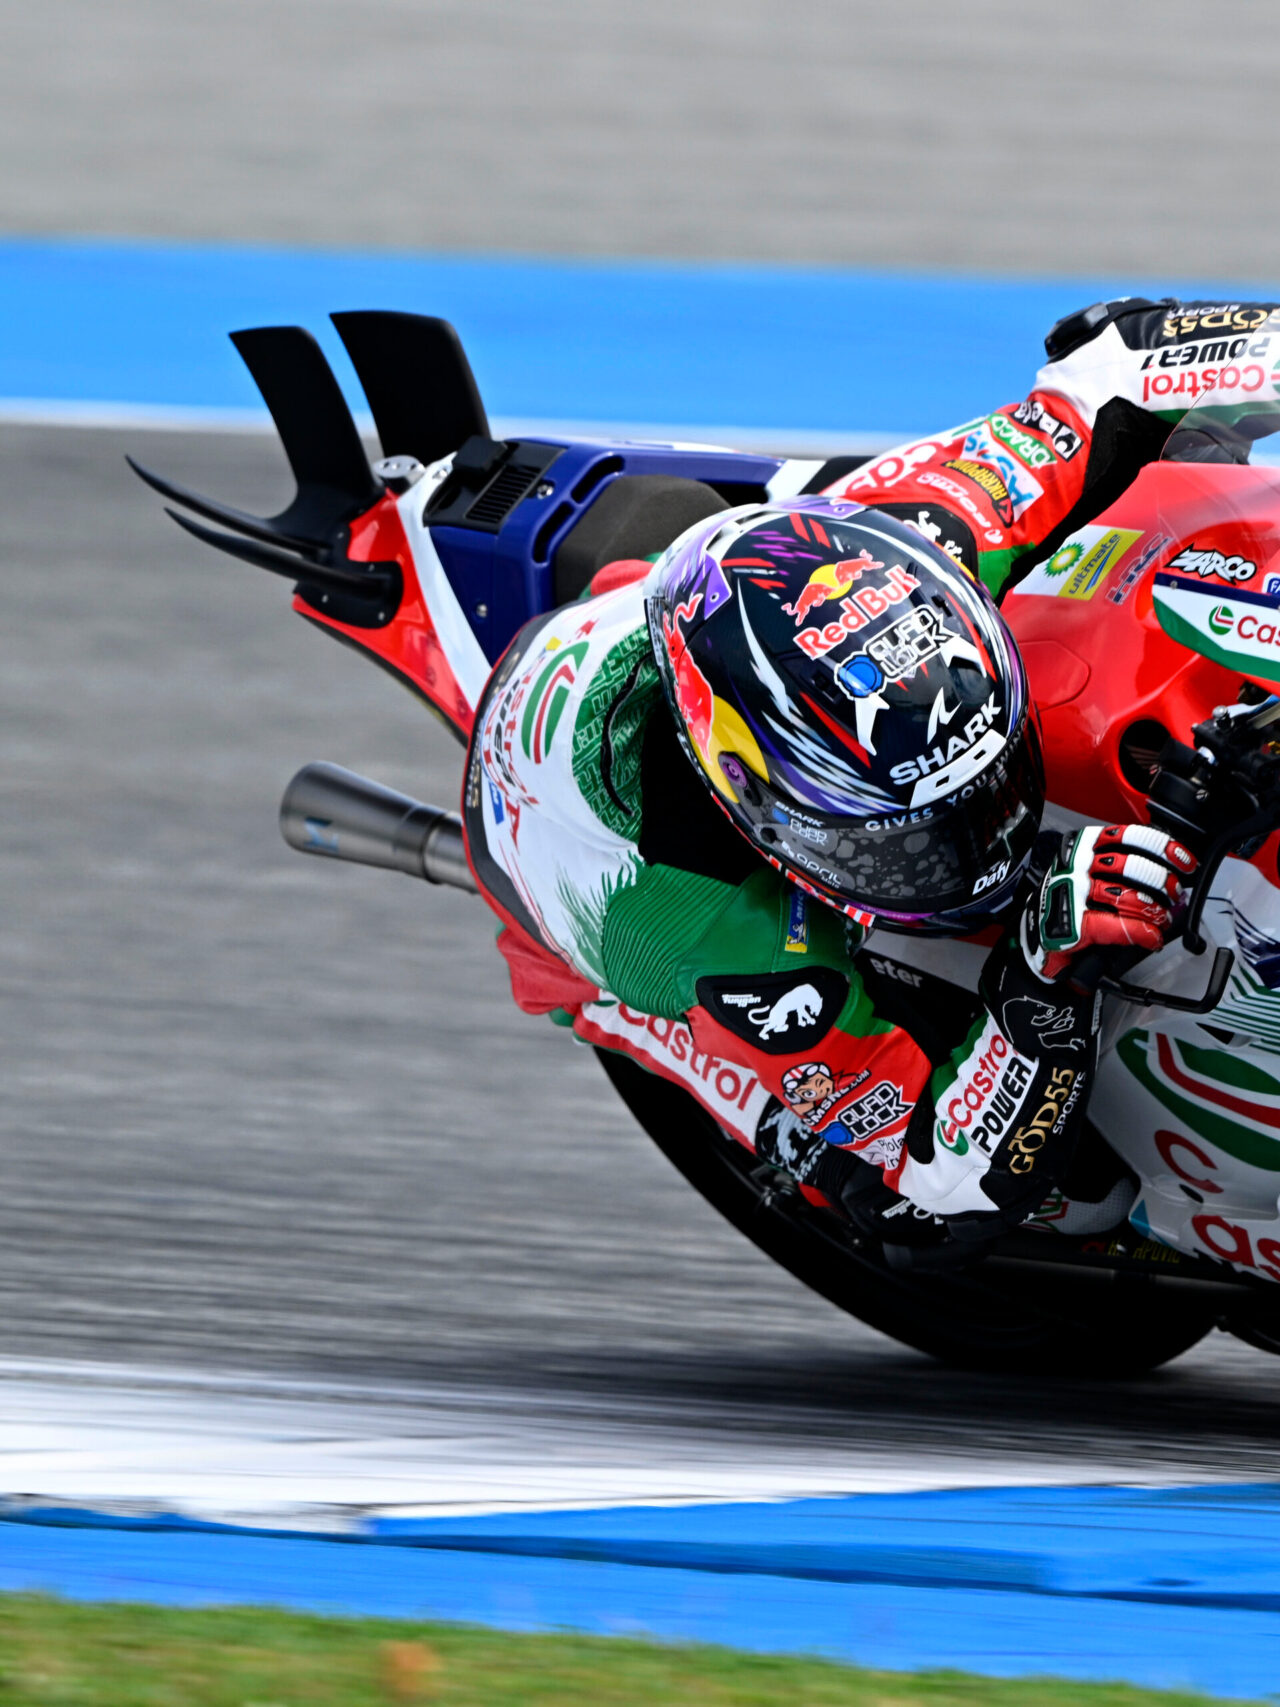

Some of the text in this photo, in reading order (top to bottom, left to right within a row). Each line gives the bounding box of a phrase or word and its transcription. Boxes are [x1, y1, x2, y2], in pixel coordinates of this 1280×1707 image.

[1143, 365, 1264, 403] Castrol
[1069, 533, 1121, 595] ultimate
[1168, 549, 1256, 582] ZARCO
[793, 564, 921, 659] Red Bull
[889, 691, 1001, 785] SHARK
[775, 801, 825, 827] SHARK
[865, 807, 934, 831] GIVES
[946, 774, 988, 807] YOU
[972, 859, 1011, 895] Dafy
[840, 1084, 894, 1126] QUAD
[948, 1034, 1018, 1129] Castro
[1052, 1071, 1087, 1136] SPORTS
[850, 1096, 906, 1138] LOCK
[1008, 1067, 1075, 1175] GOD55
